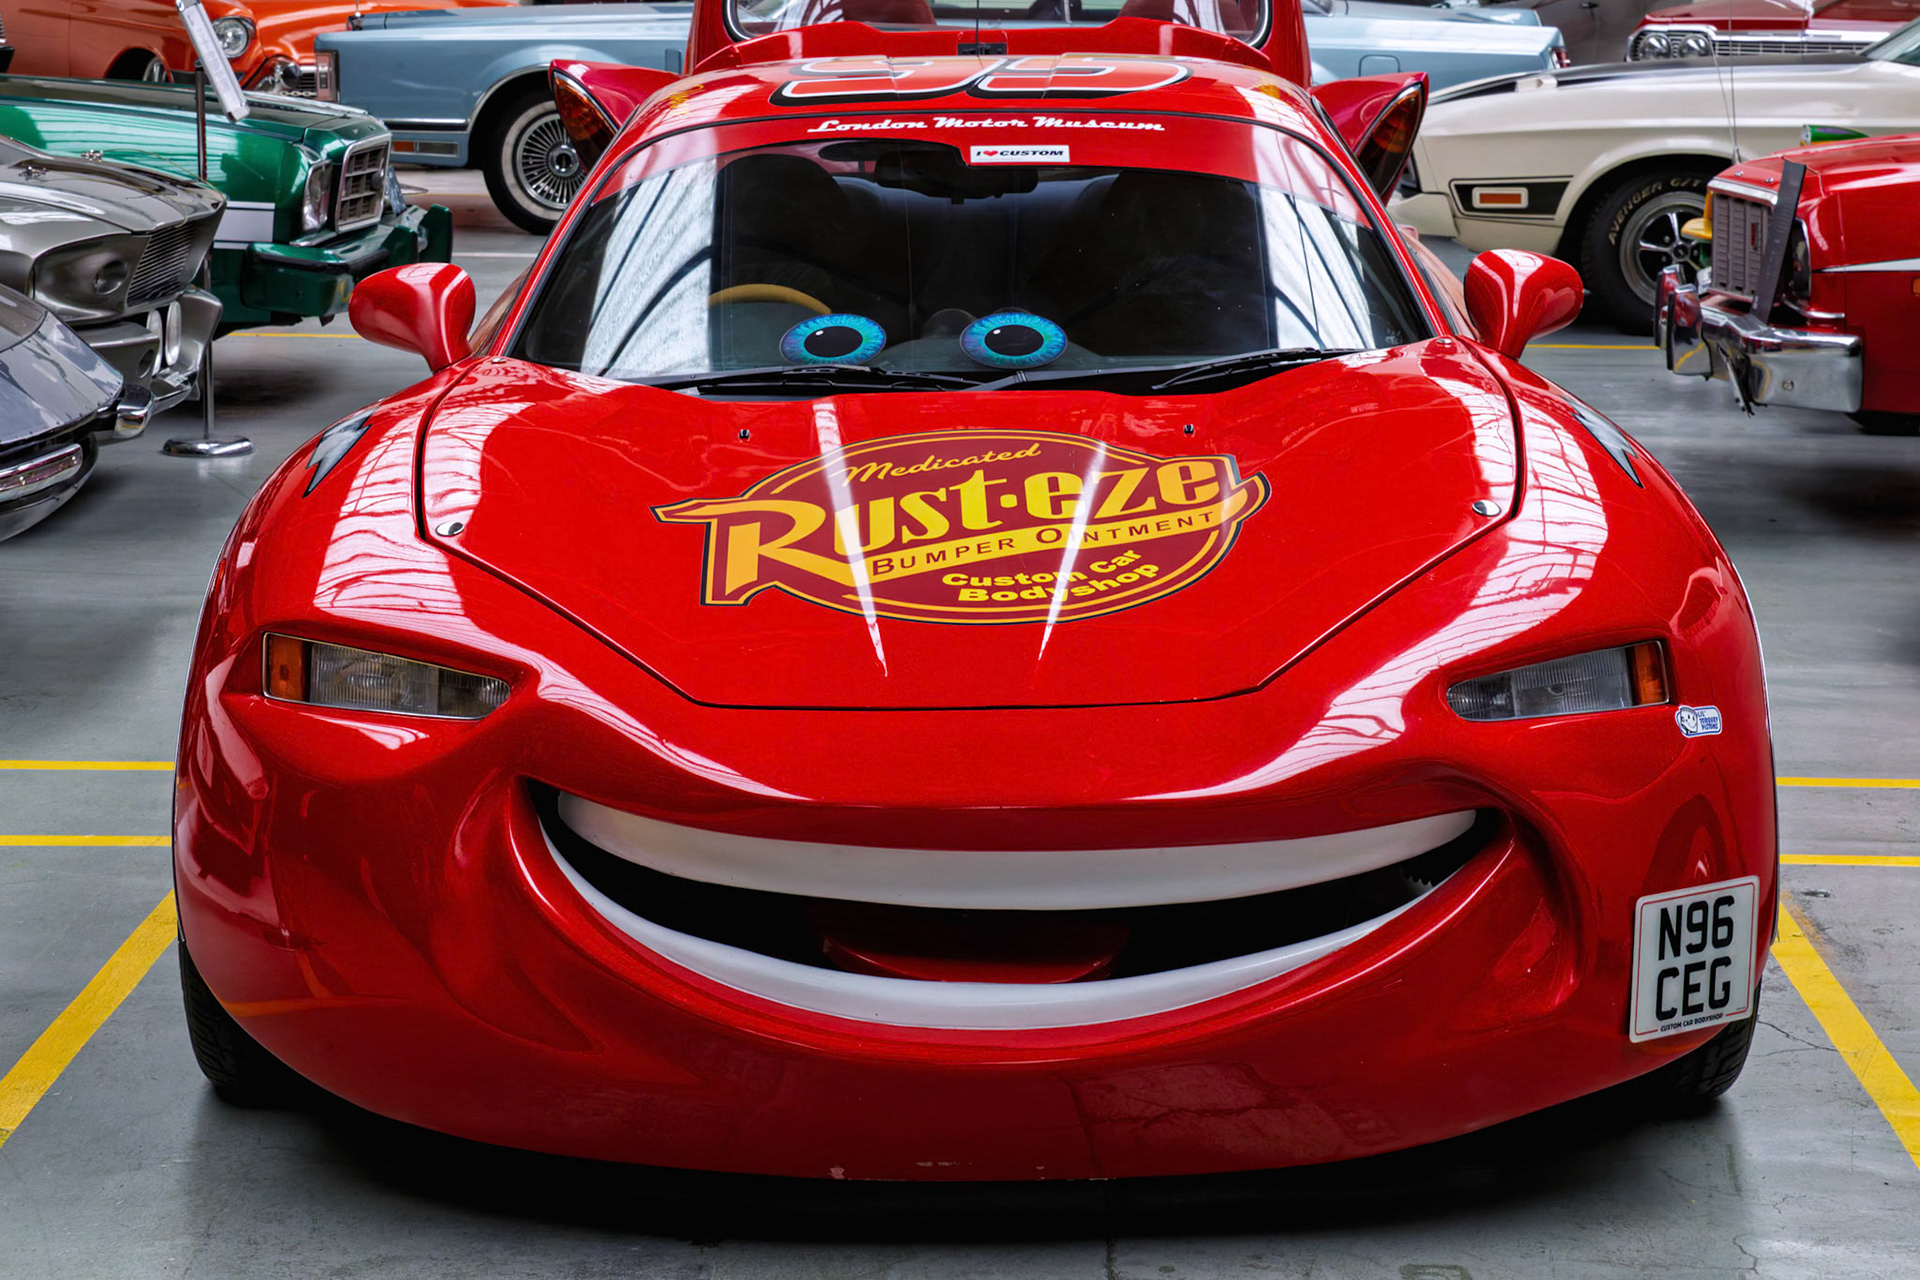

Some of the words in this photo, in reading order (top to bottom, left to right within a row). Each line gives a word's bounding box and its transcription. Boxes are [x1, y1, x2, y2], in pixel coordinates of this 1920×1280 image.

[768, 56, 1194, 107] 95
[807, 119, 927, 133] London
[933, 116, 1029, 128] Motor
[1032, 116, 1166, 131] Museum
[1608, 181, 1663, 246] AVENGER
[828, 443, 1041, 487] Medicated
[872, 537, 1015, 576] BUMPER
[1035, 511, 1214, 545] OINTMENT
[941, 569, 1087, 587] Custom
[1090, 549, 1142, 573] Car
[958, 563, 1160, 602] Bodyshop
[1658, 895, 1735, 961] N96
[1655, 956, 1732, 1021] CEG
[1660, 1021, 1682, 1032] CUSTOM
[1683, 1019, 1693, 1028] CAR
[1694, 1013, 1724, 1025] BODYSHOP
